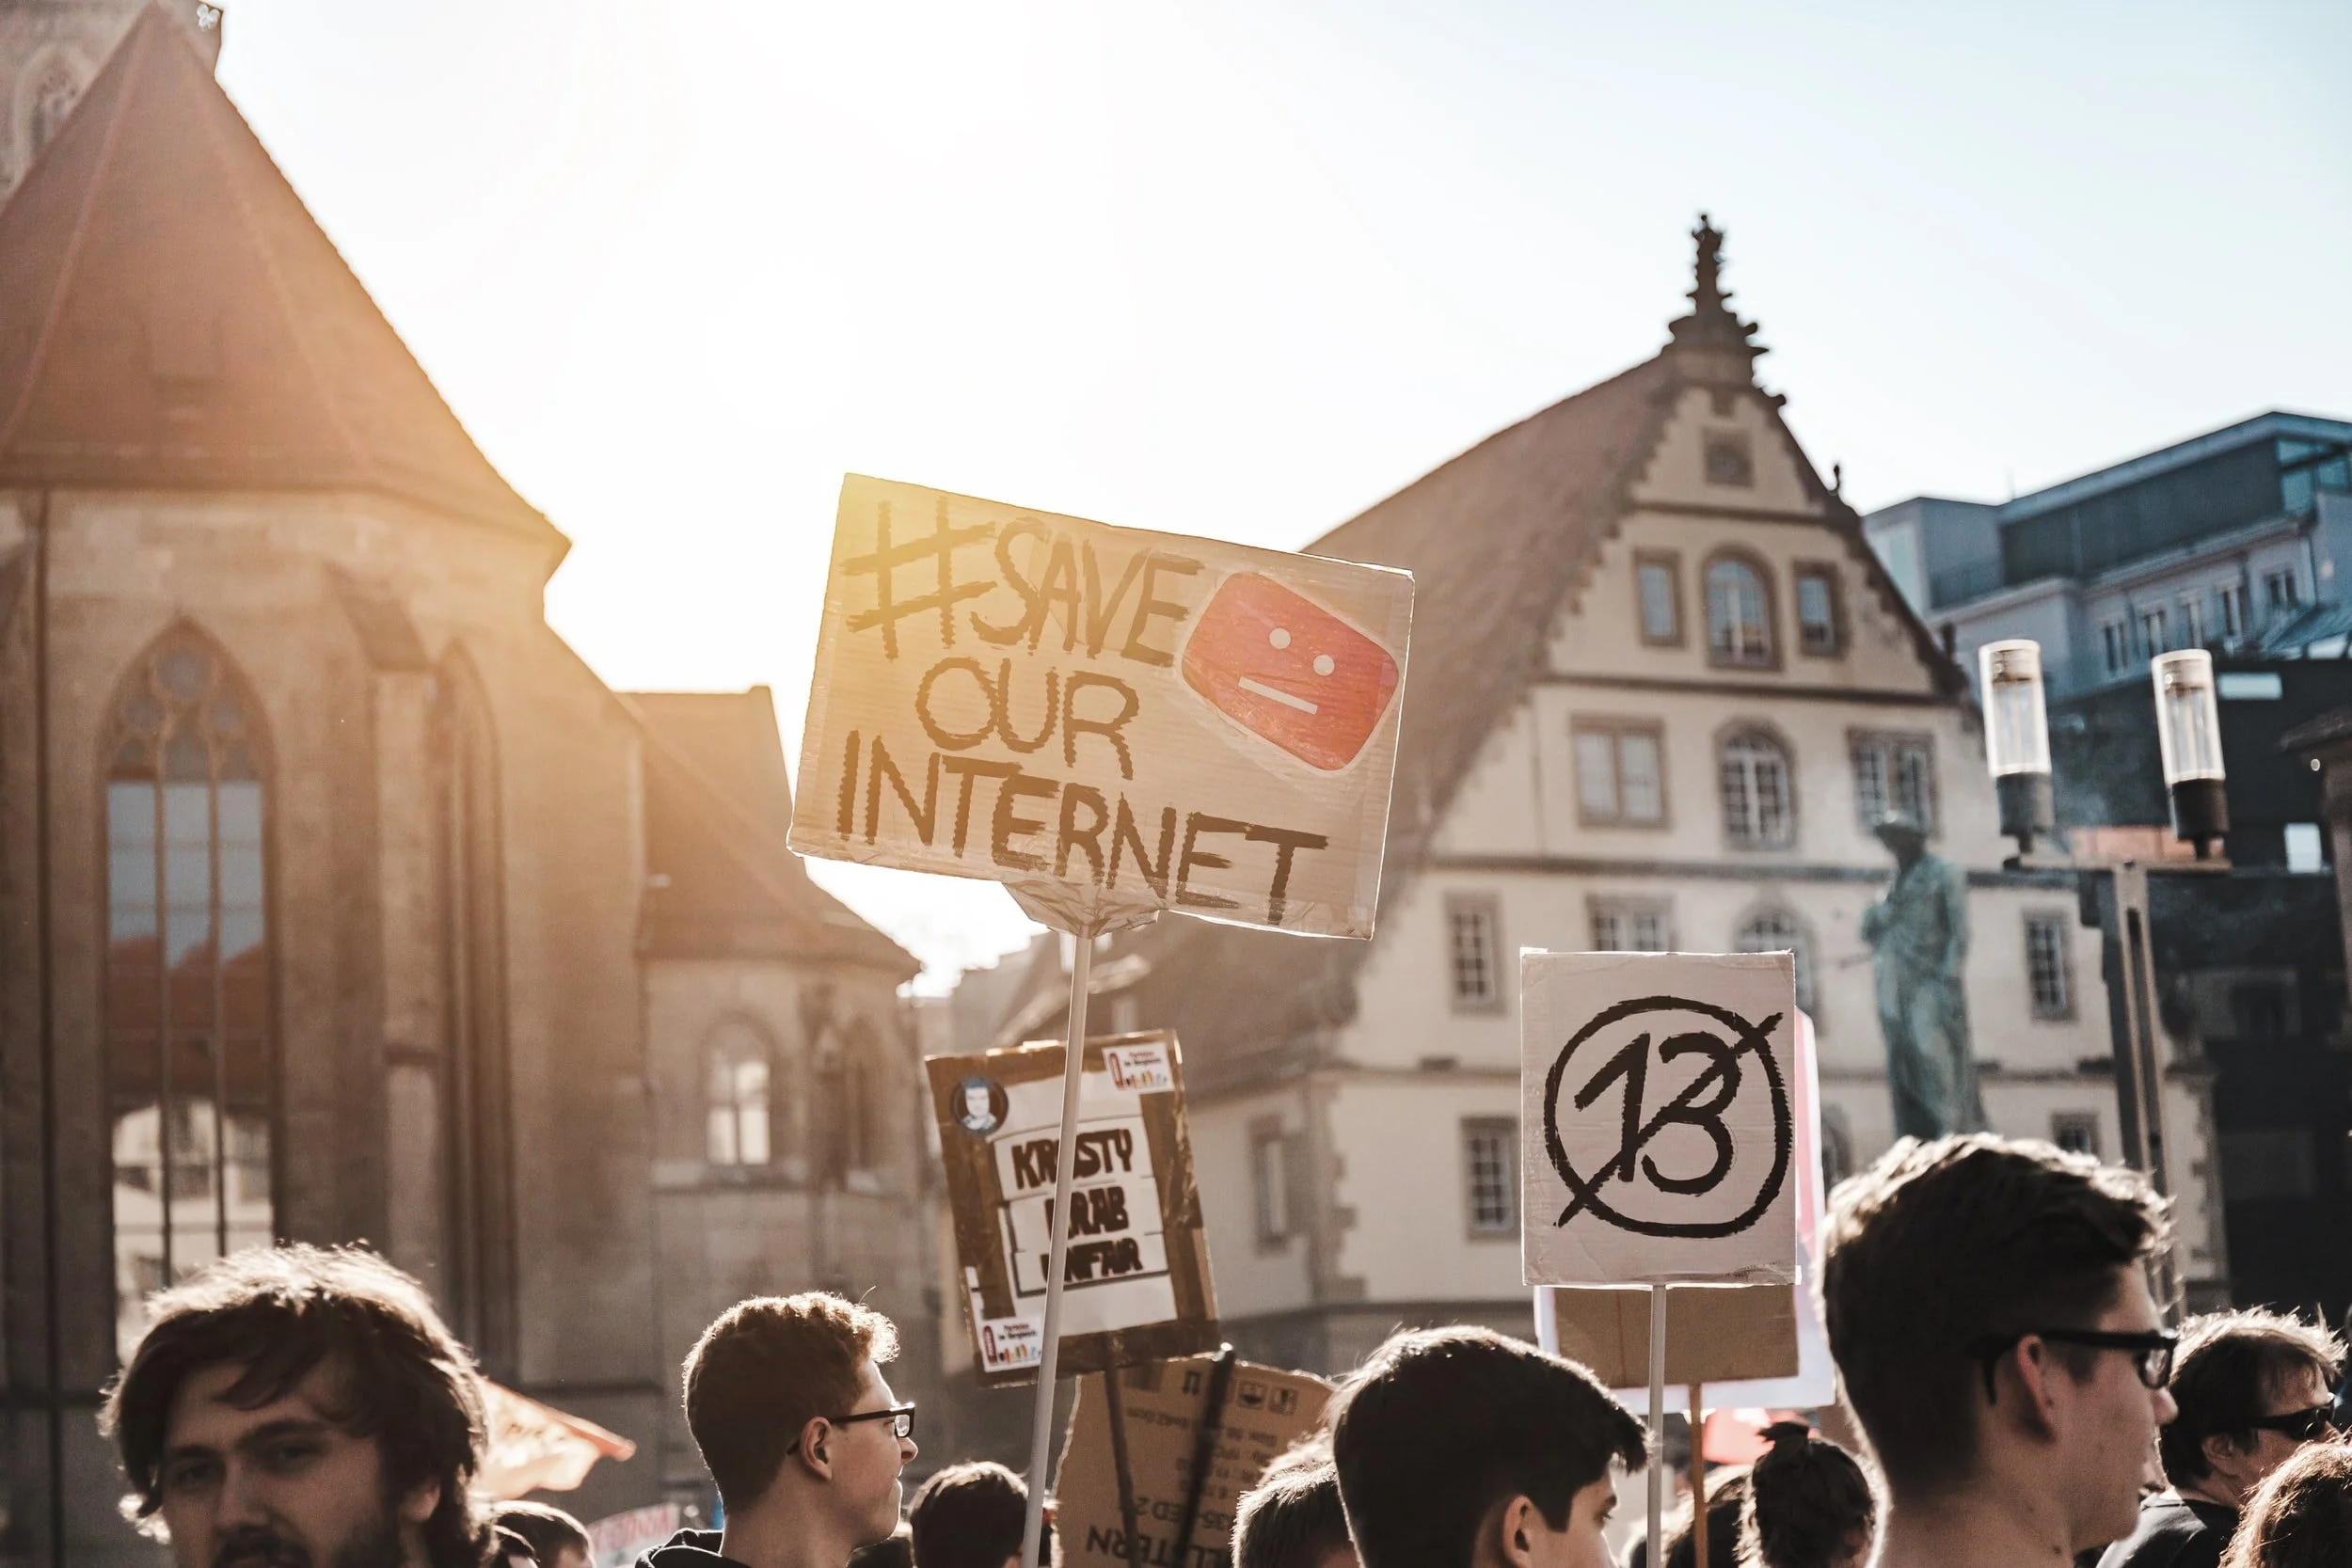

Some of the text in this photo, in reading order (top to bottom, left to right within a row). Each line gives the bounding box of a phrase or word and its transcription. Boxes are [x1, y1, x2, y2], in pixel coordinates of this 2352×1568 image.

[840, 496, 1202, 667] #SAVE
[915, 657, 1139, 780] OUR
[836, 730, 1328, 925] INTERNET
[1011, 1129, 1133, 1190] KRSTY
[1574, 1031, 1741, 1196] 13
